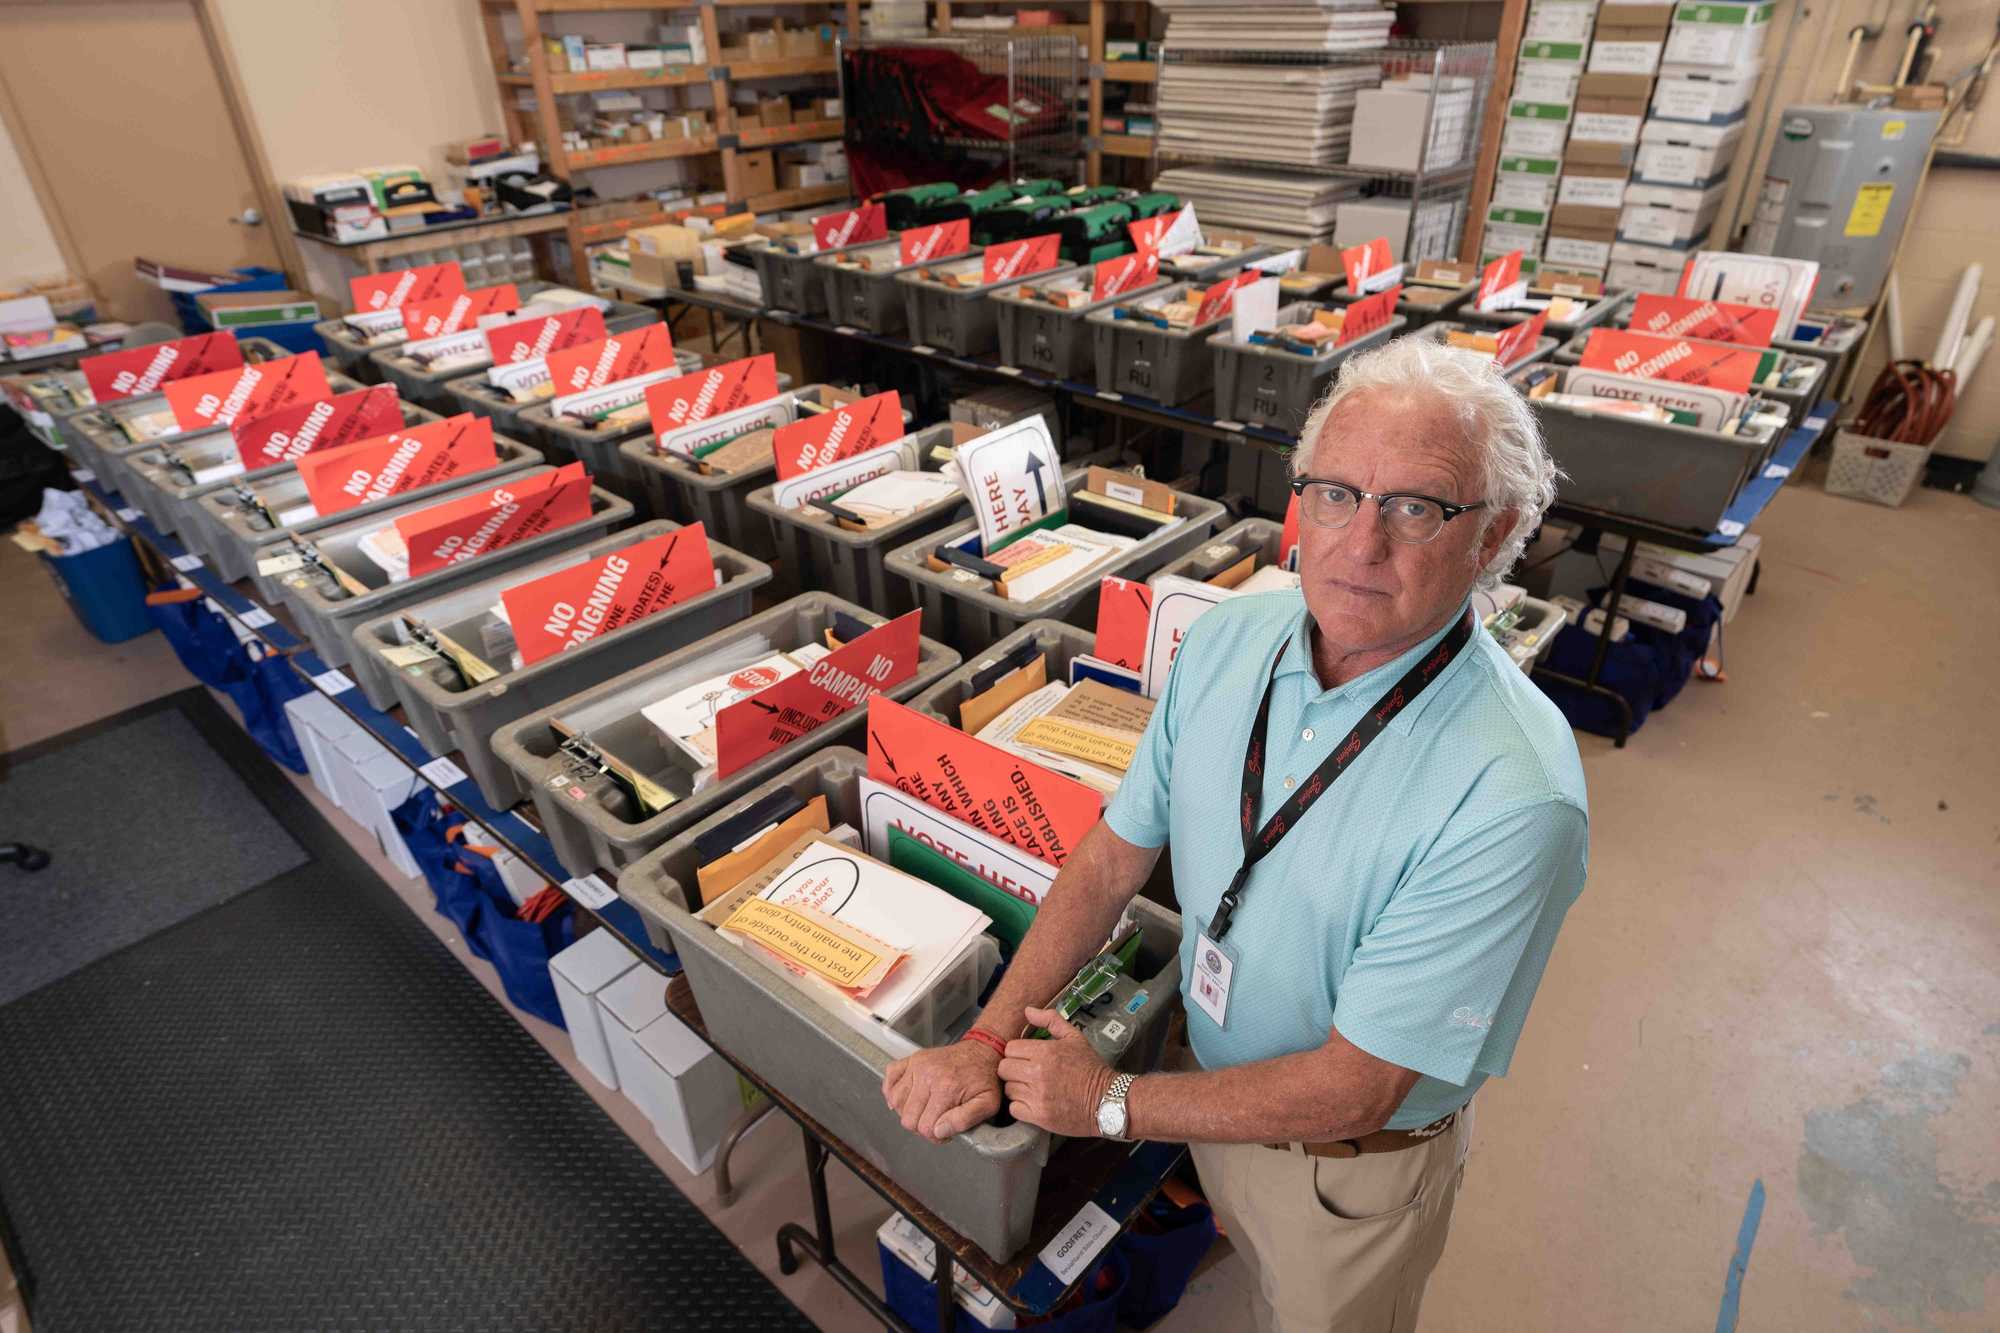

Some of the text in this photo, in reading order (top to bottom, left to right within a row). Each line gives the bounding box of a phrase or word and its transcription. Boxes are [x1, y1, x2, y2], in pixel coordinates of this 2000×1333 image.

[1648, 311, 1671, 331] NO
[511, 341, 530, 363] NO
[1613, 350, 1640, 373] NO
[111, 370, 138, 394] NO
[570, 366, 590, 391] NO
[1129, 369, 1151, 387] RU
[1264, 366, 1274, 381] 2
[194, 393, 221, 419] NO
[668, 397, 690, 424] NO
[1253, 399, 1278, 417] RU
[262, 432, 290, 458] NO
[796, 443, 817, 470] NO
[343, 470, 372, 497] NO
[984, 471, 1009, 534] HERE
[433, 535, 464, 558] NO
[655, 581, 676, 606] THE
[543, 602, 576, 638] NO
[738, 669, 773, 688] STOP
[865, 654, 894, 682] NO
[821, 700, 838, 715] BY
[909, 771, 931, 802] THE
[936, 753, 974, 812] WHICH
[931, 781, 955, 811] ANY
[1002, 795, 1022, 817] IS
[796, 878, 815, 894] you
[811, 876, 830, 894] your
[749, 919, 789, 943] outside
[755, 905, 863, 962] the main entry door
[790, 938, 810, 955] the
[811, 950, 827, 963] on
[826, 960, 855, 979] Post
[1056, 1220, 1093, 1259] GODFREY 3
